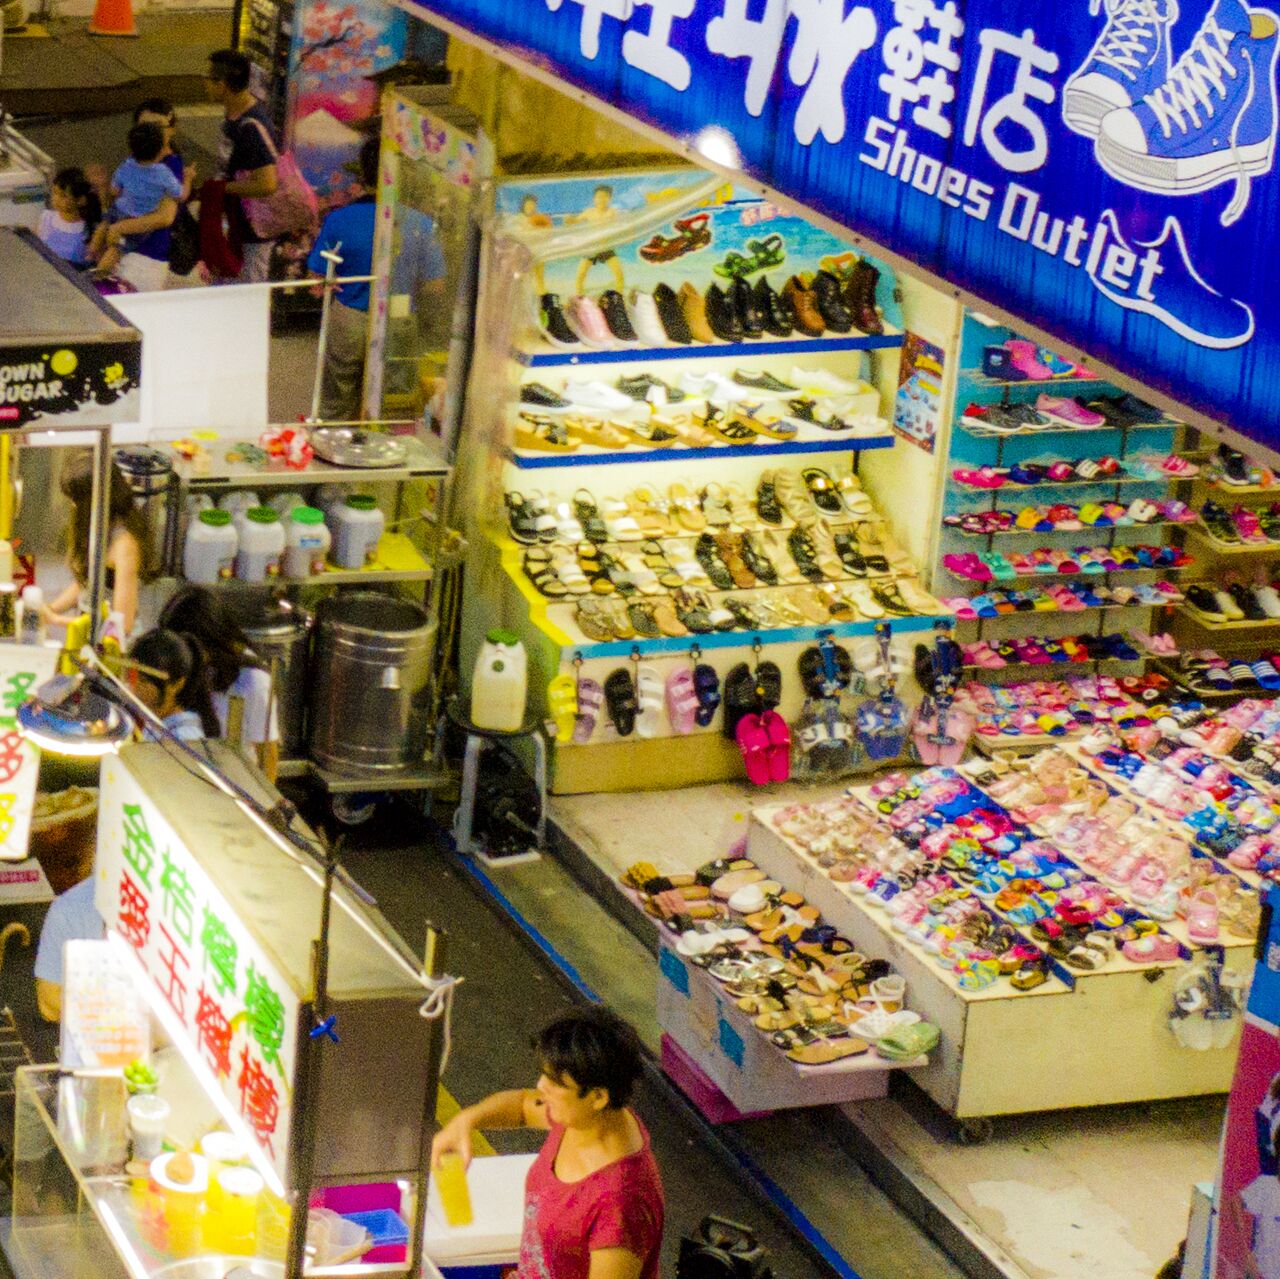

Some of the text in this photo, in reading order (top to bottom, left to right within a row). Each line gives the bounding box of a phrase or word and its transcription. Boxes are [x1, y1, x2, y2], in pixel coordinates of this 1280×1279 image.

[859, 114, 1164, 301] Shoes Outlet
[121, 803, 285, 1063] 金桔檸檬
